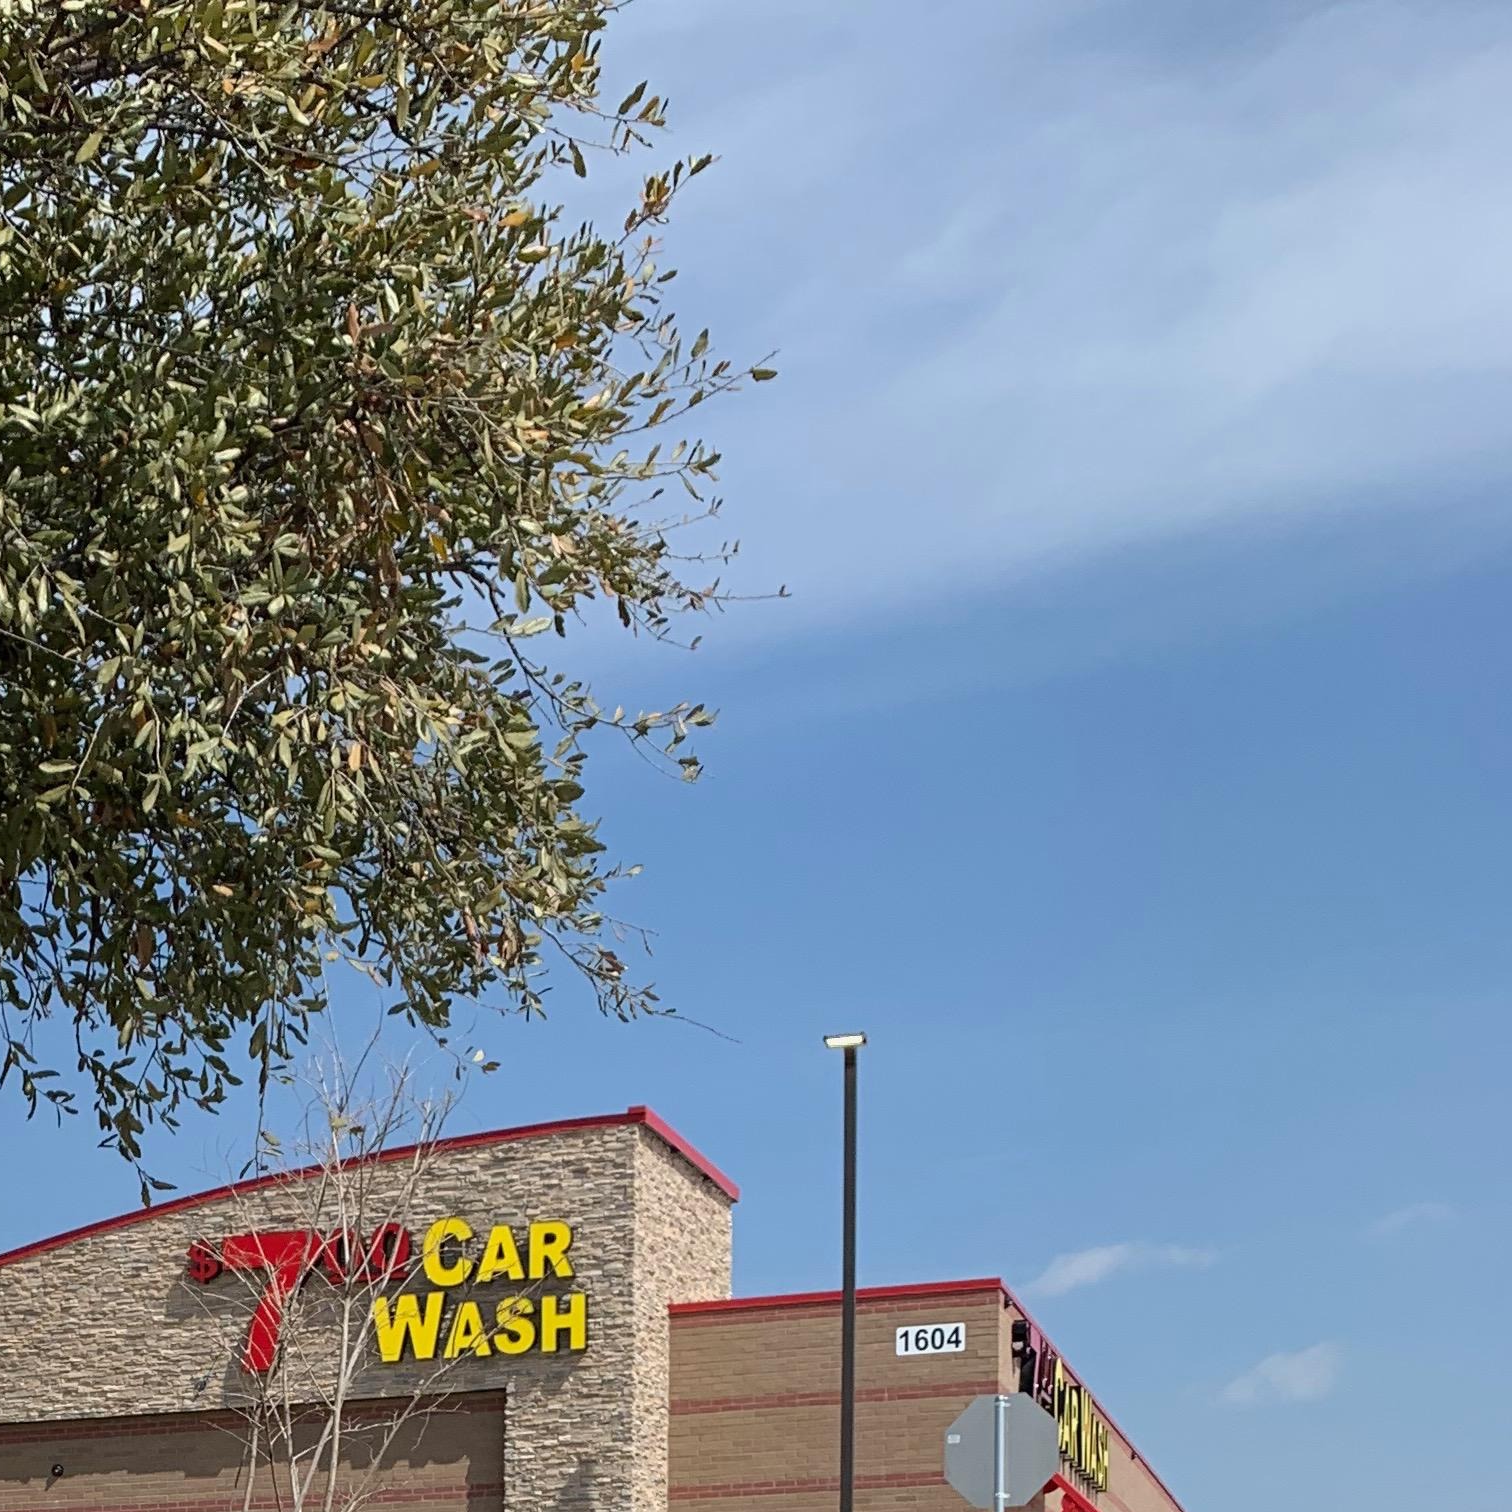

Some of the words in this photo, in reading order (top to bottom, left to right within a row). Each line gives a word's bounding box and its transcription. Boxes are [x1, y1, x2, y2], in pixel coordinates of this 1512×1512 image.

[422, 1216, 575, 1287] CAR
[374, 1291, 586, 1361] WASH
[899, 1326, 962, 1352] 1604
